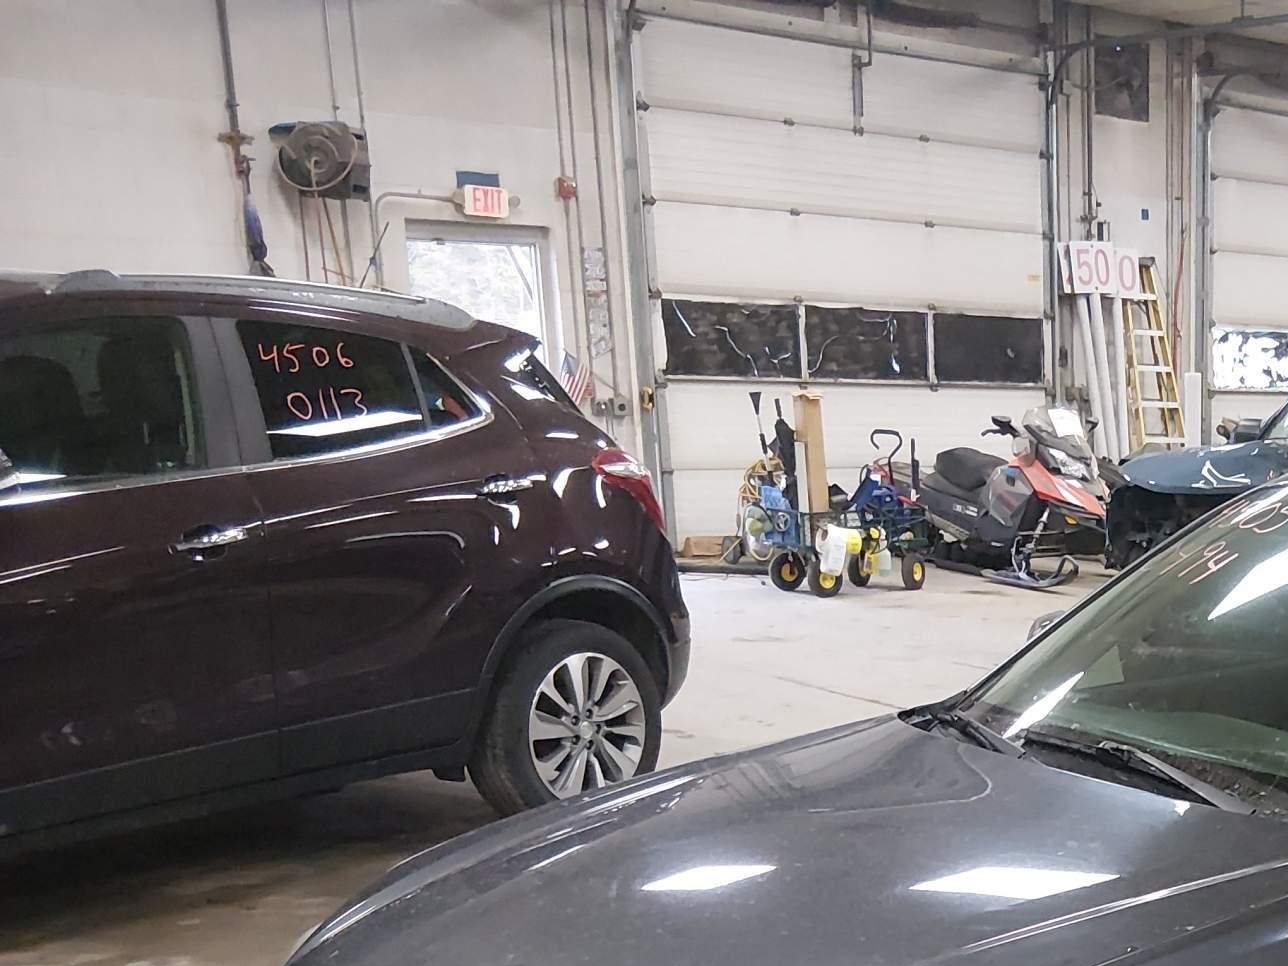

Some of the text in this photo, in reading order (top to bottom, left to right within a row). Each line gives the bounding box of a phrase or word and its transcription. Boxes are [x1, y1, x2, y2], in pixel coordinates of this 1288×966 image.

[472, 187, 503, 214] EXIT
[1076, 248, 1110, 286] 50
[258, 342, 354, 373] 4506
[286, 387, 367, 421] 0113
